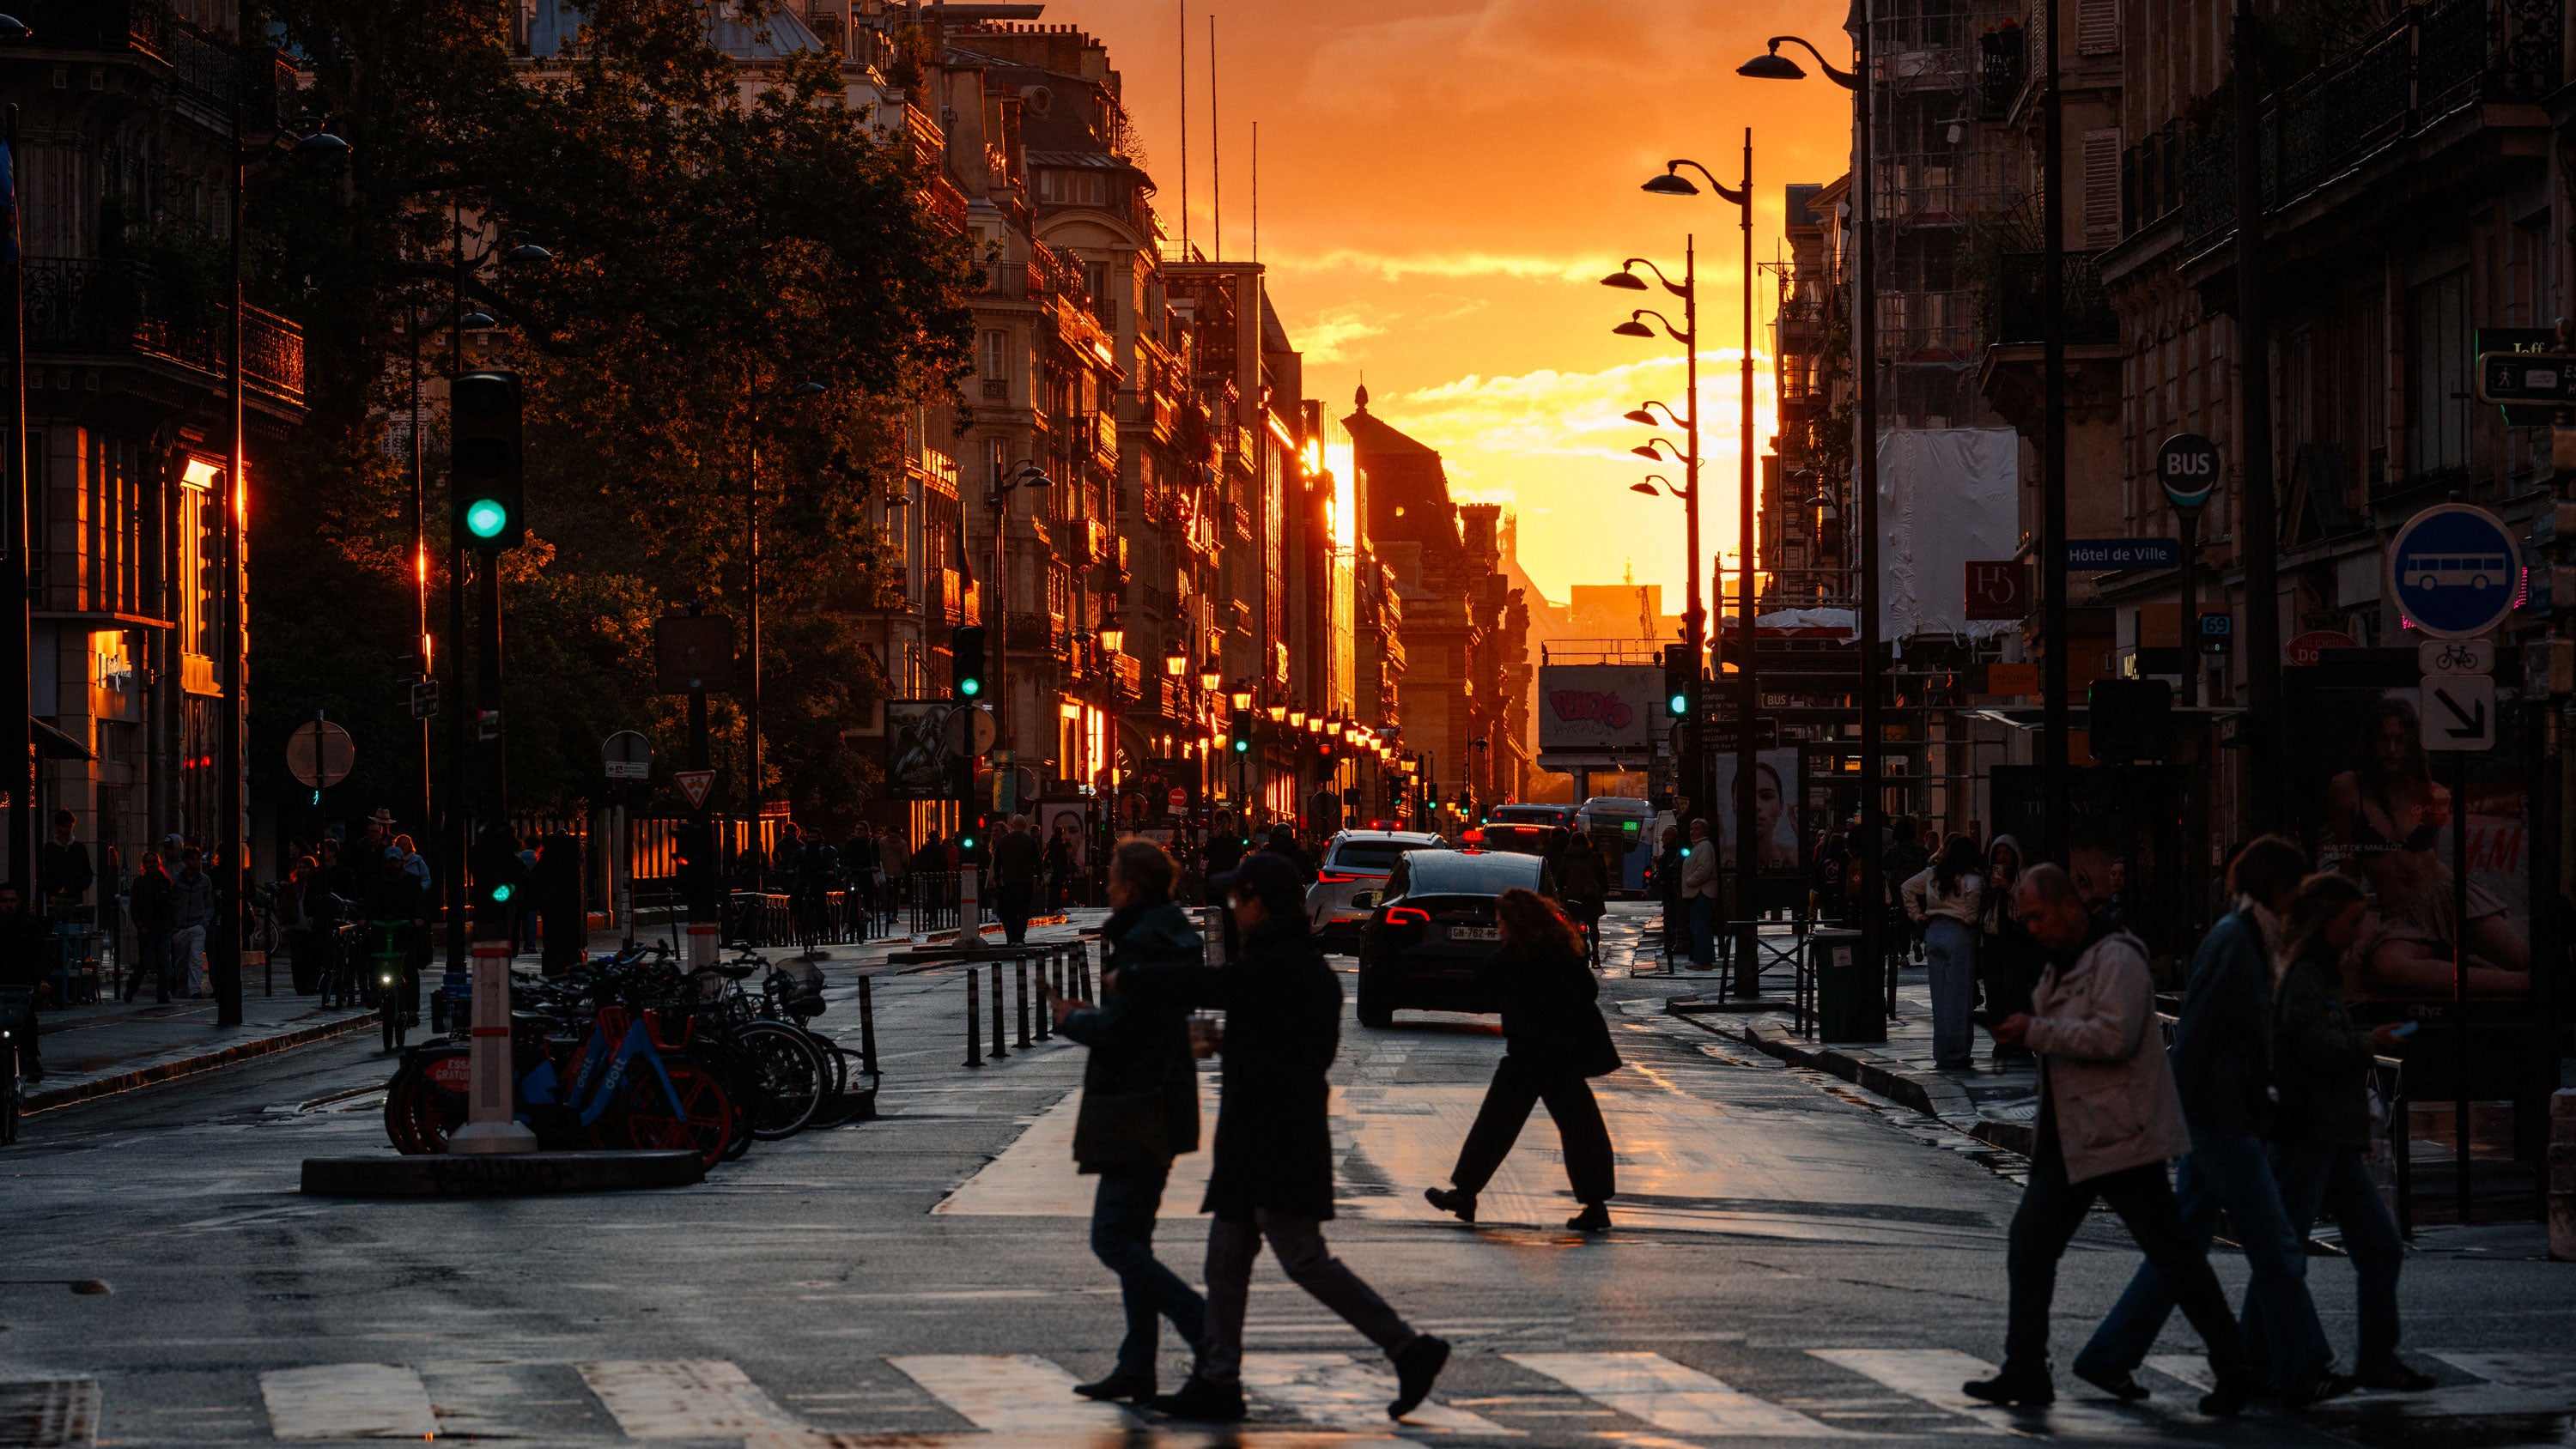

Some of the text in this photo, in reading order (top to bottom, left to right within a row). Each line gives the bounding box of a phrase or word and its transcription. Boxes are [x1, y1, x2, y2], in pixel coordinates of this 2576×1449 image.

[2166, 452, 2210, 476] BUS
[2069, 547, 2167, 561] Hôtel de Ville
[2206, 617, 2227, 633] 69
[2301, 635, 2346, 648] Brioche
[1767, 694, 1786, 706] BUS
[2364, 843, 2403, 852] MAILLOT
[576, 1056, 594, 1088] dott
[605, 1058, 628, 1089] dott
